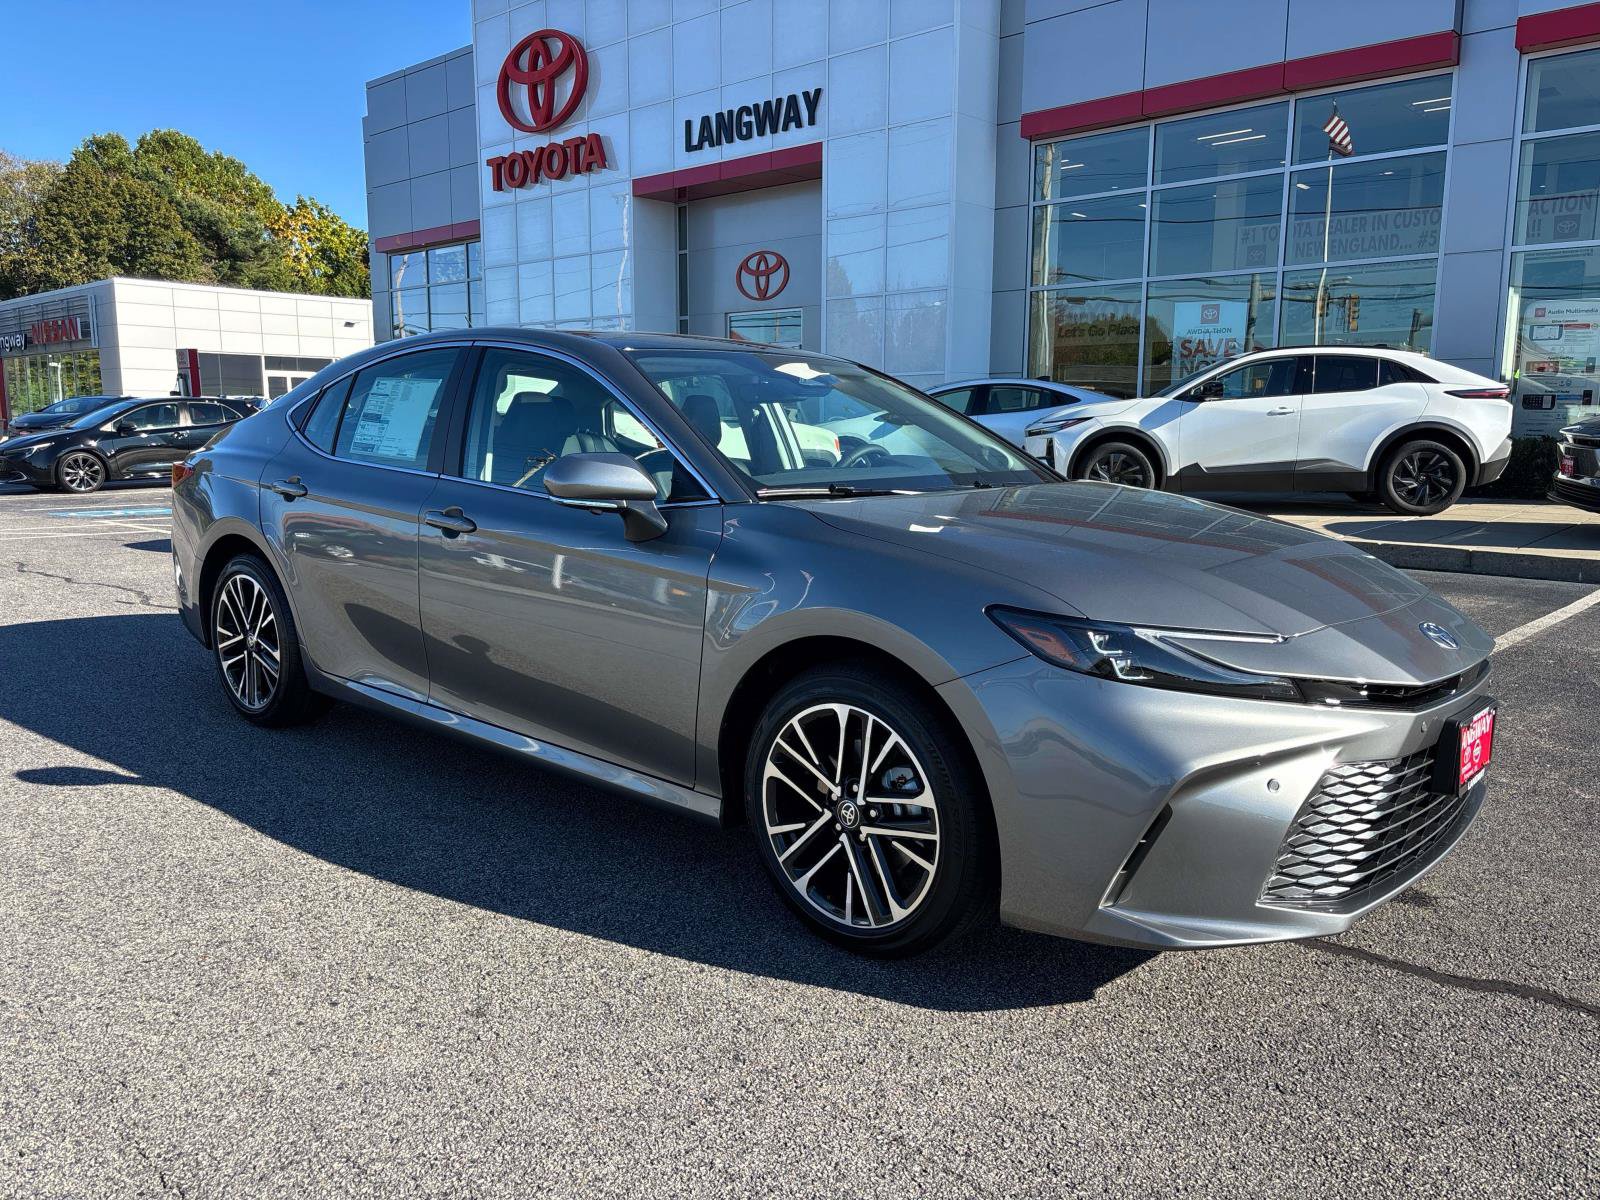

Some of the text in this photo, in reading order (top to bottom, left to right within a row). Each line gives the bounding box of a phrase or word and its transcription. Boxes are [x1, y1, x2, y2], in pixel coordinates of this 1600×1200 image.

[685, 87, 822, 152] LANGWAY
[486, 132, 607, 192] TOYOTA
[1316, 215, 1367, 235] DEALER
[1371, 213, 1389, 231] IN
[31, 315, 79, 345] NISSAN
[1057, 325, 1085, 338] Let's
[1088, 325, 1105, 337] Go
[1180, 337, 1237, 359] SAVE
